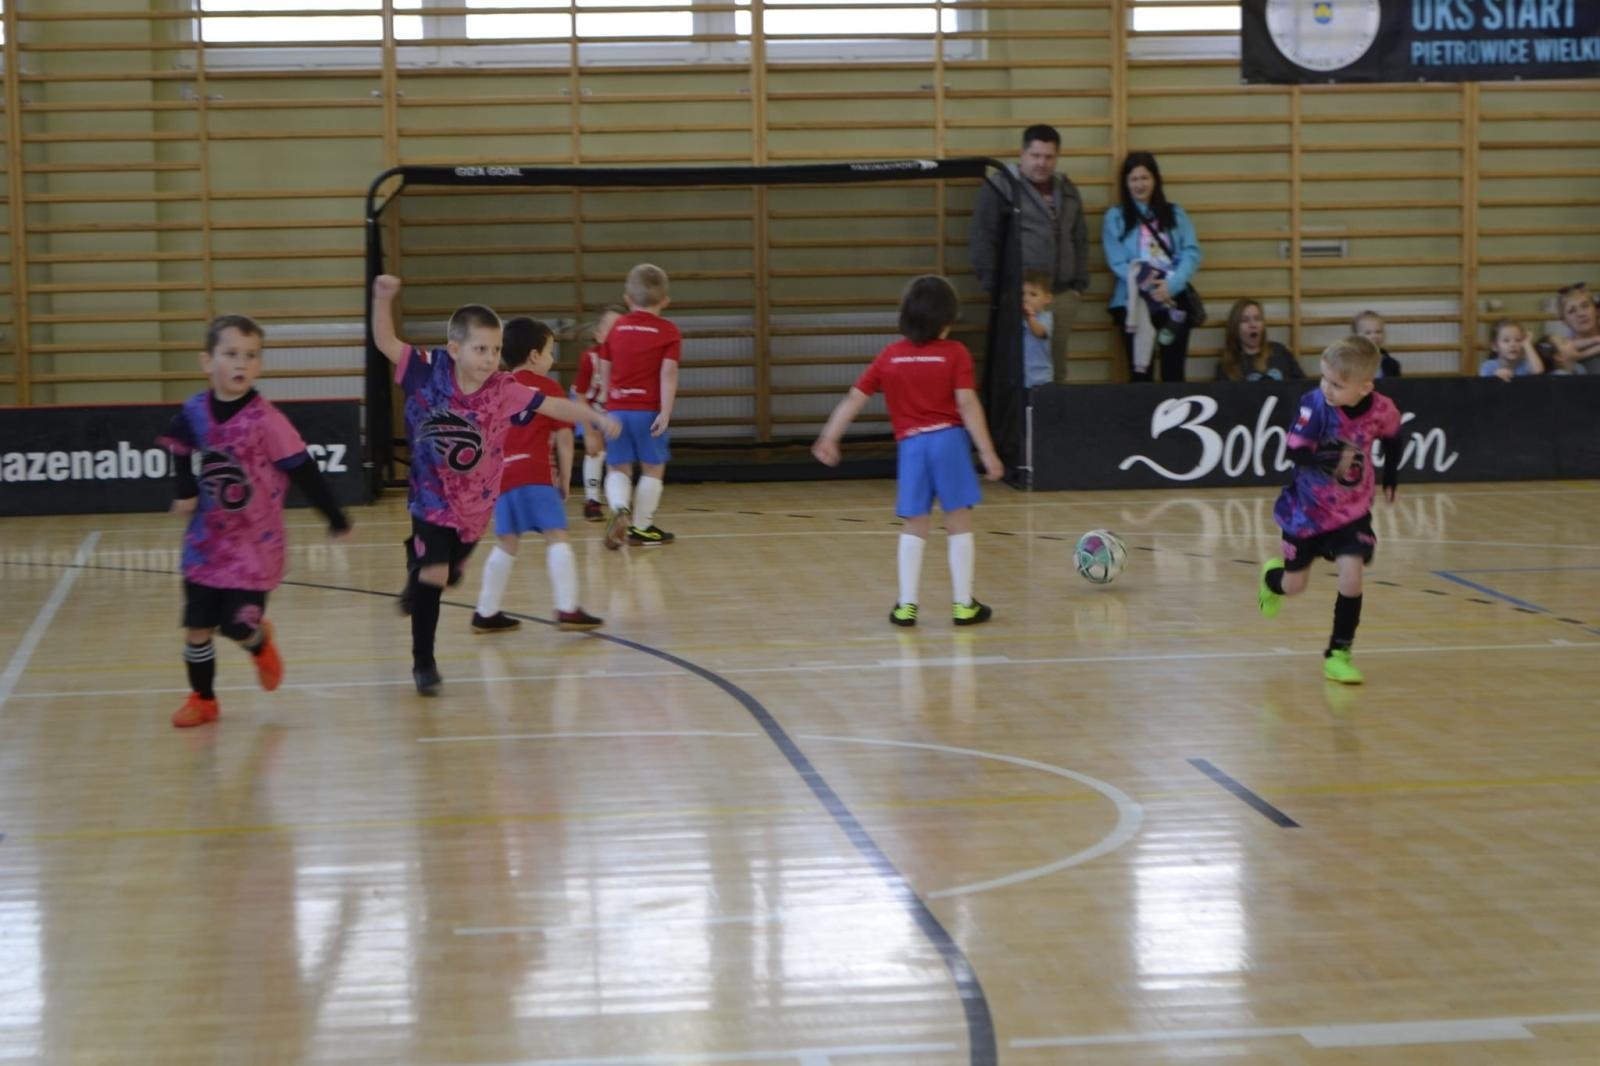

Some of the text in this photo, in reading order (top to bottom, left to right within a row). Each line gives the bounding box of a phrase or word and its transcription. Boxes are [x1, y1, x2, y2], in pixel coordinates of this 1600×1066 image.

[1412, 0, 1576, 31] UKS START
[1411, 39, 1531, 64] PIETROWICE
[487, 166, 524, 177] GOAL
